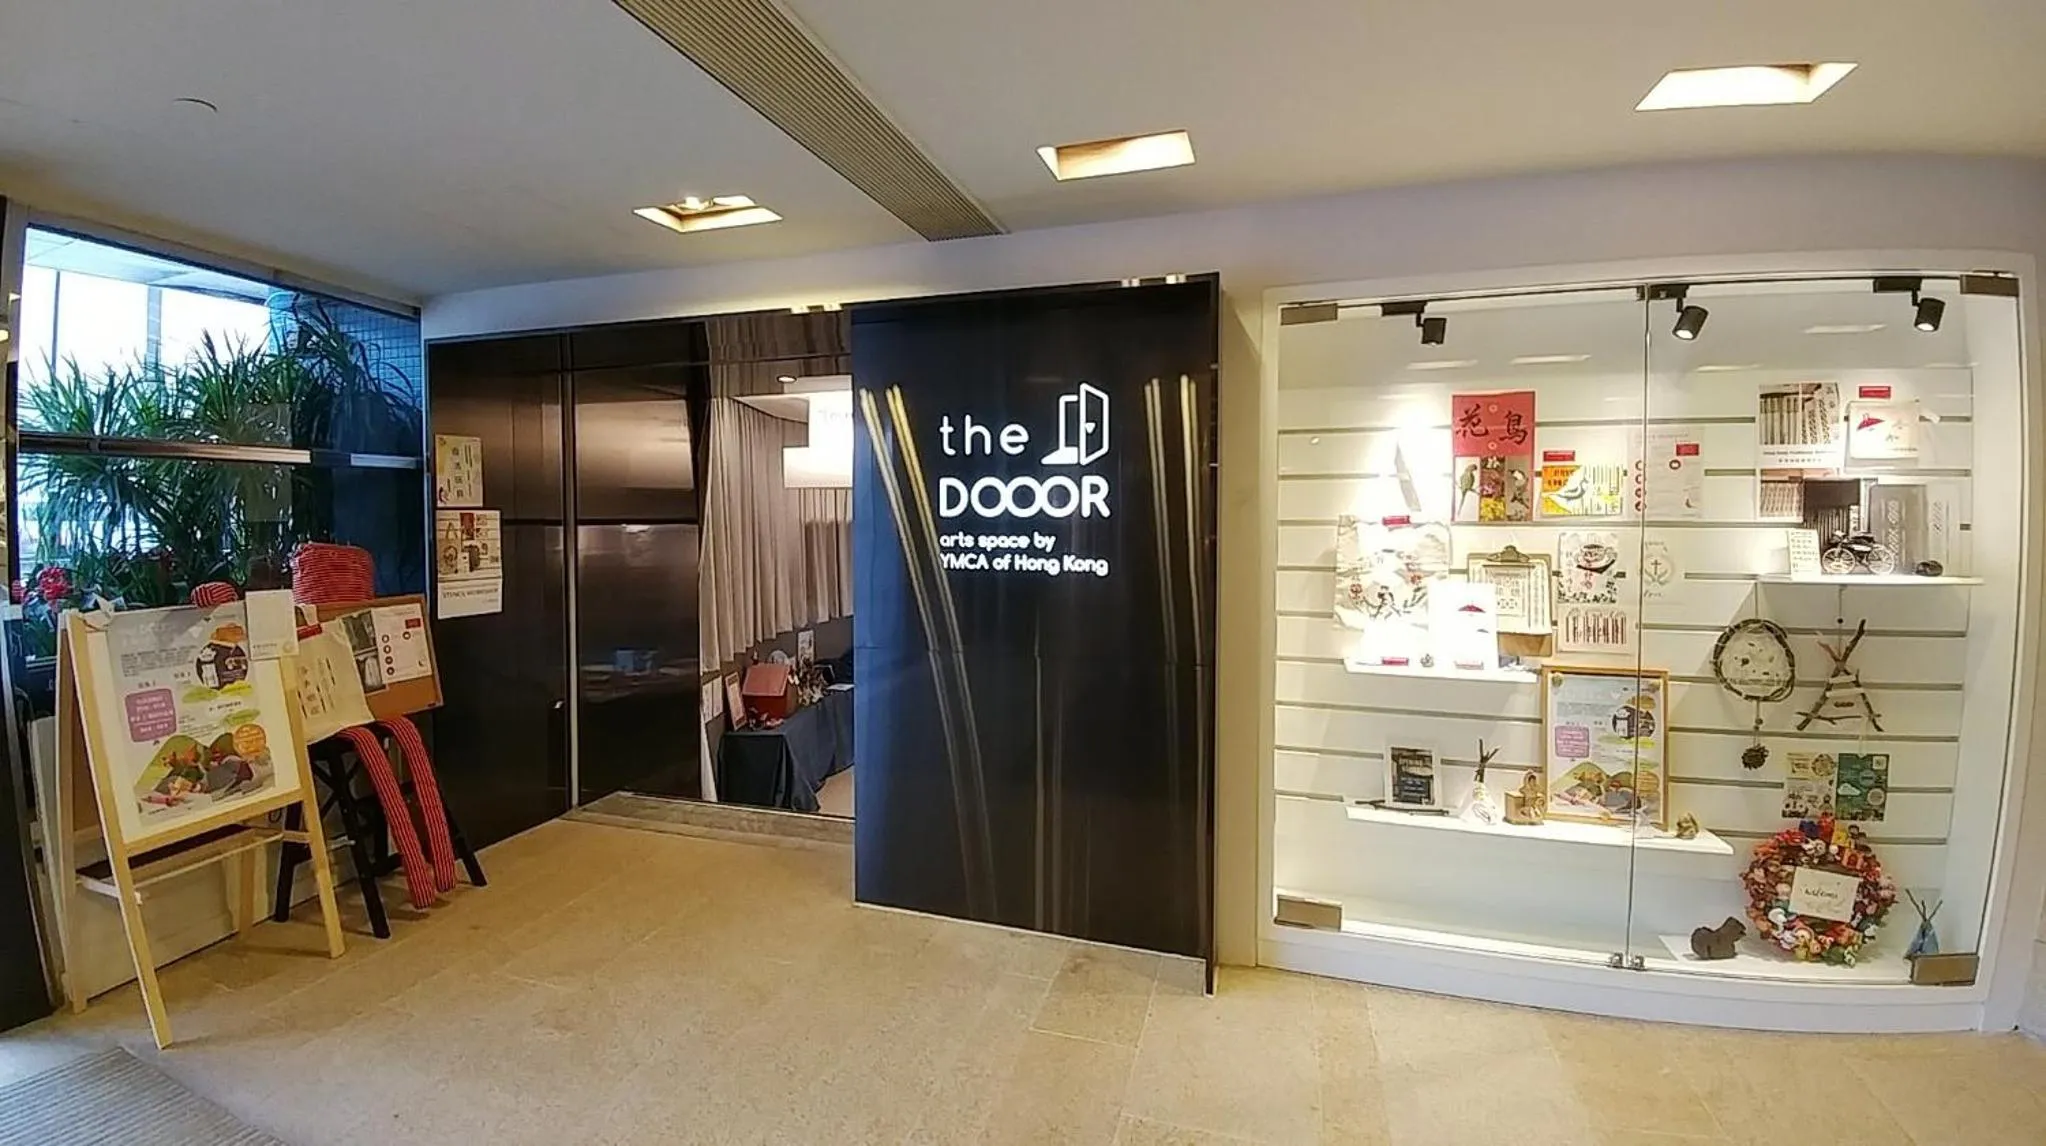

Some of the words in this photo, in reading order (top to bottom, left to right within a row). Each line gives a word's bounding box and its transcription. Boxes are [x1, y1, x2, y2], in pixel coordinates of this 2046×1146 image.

[939, 414, 1030, 456] the
[939, 475, 1111, 518] DOOOR
[939, 531, 975, 548] arts
[977, 535, 1031, 552] space
[1033, 531, 1057, 553] by
[939, 552, 990, 570] YMCA
[992, 553, 1012, 571] of
[1014, 553, 1061, 576] Hong
[1062, 554, 1109, 577] Kong
